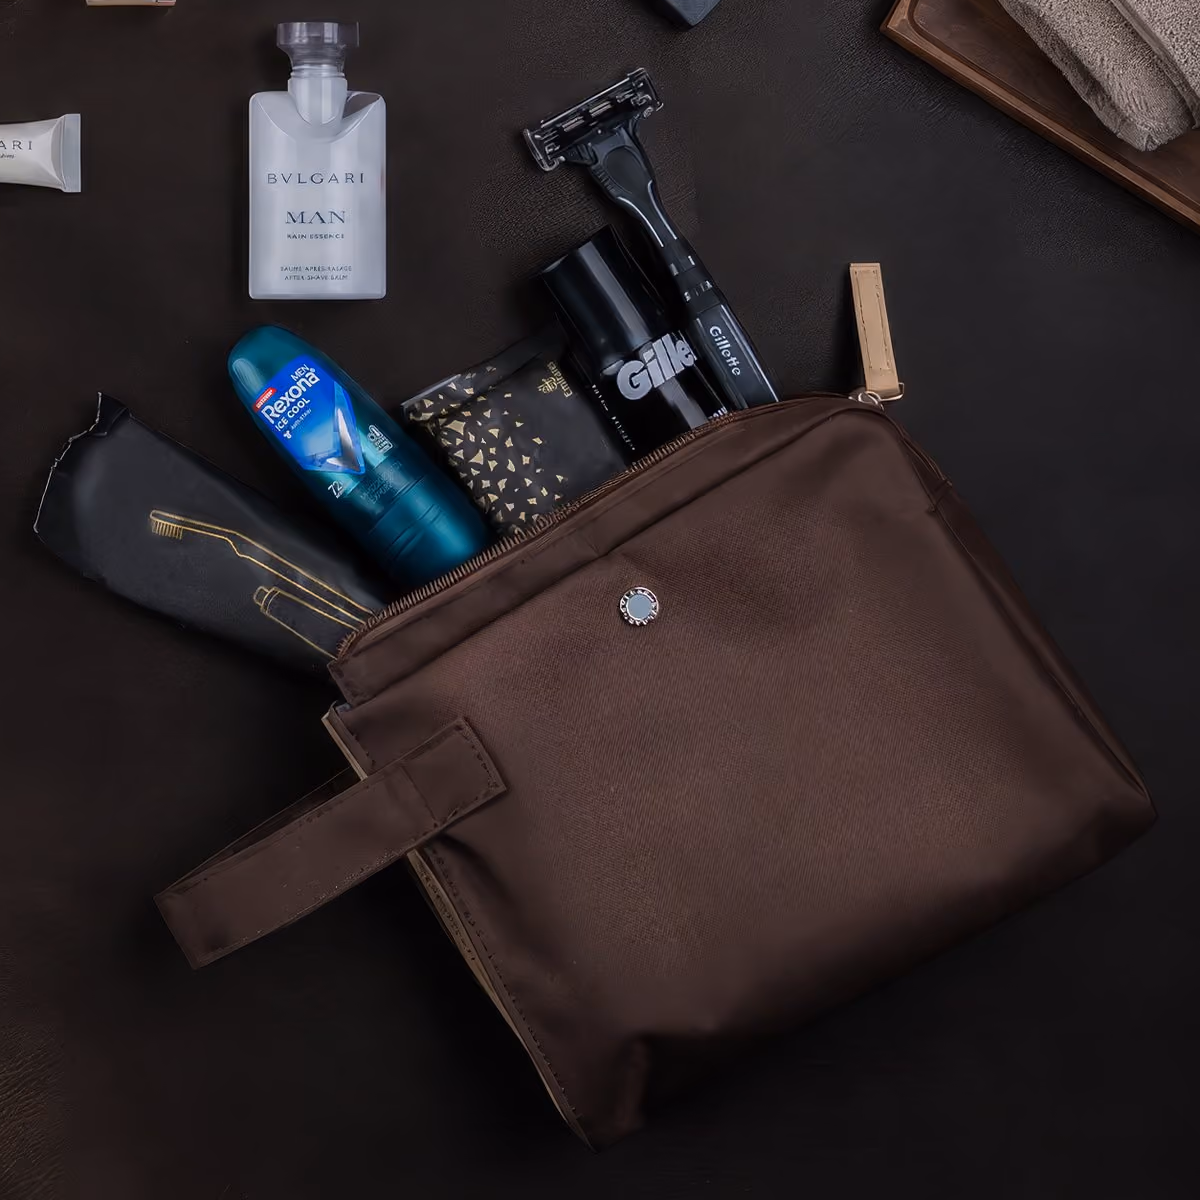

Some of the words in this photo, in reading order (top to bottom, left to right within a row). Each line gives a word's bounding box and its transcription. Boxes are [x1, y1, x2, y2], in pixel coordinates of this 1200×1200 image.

[267, 172, 365, 185] BVLGARI
[285, 210, 347, 225] MAN
[708, 325, 742, 377] Gillette
[290, 363, 311, 382] MEN
[261, 369, 320, 424] Rexona
[275, 414, 290, 432] ICE
[287, 397, 311, 417] COOL
